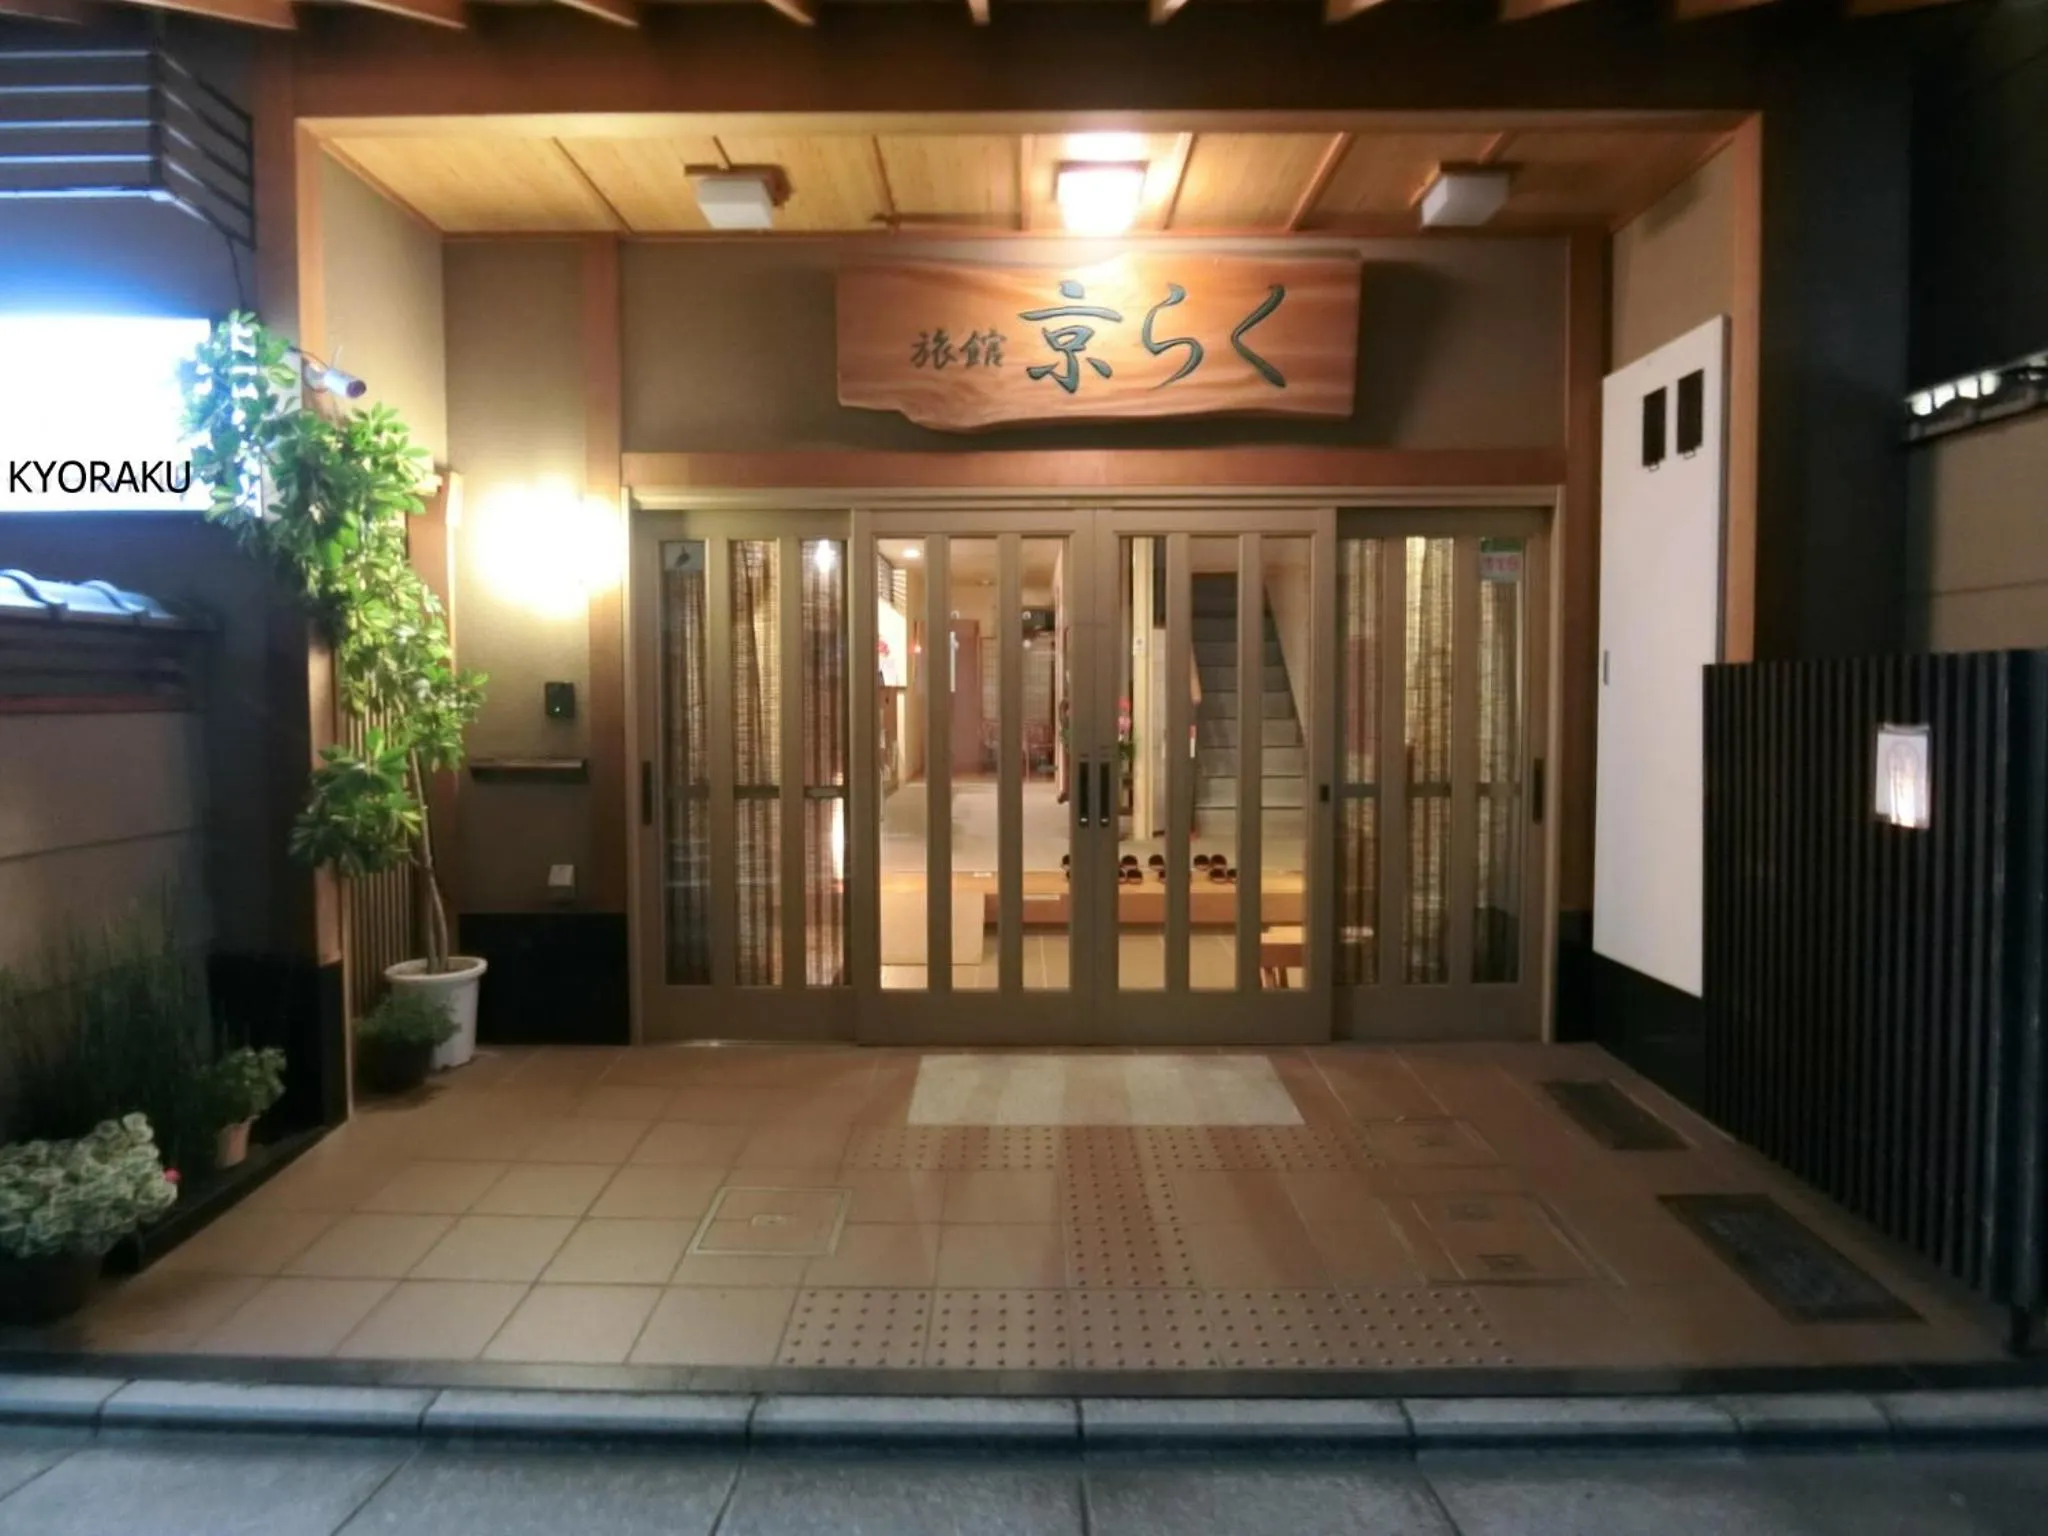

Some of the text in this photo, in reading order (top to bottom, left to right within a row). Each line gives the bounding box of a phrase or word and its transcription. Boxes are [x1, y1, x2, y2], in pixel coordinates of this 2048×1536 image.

[910, 281, 1287, 393] 旅館 京らく
